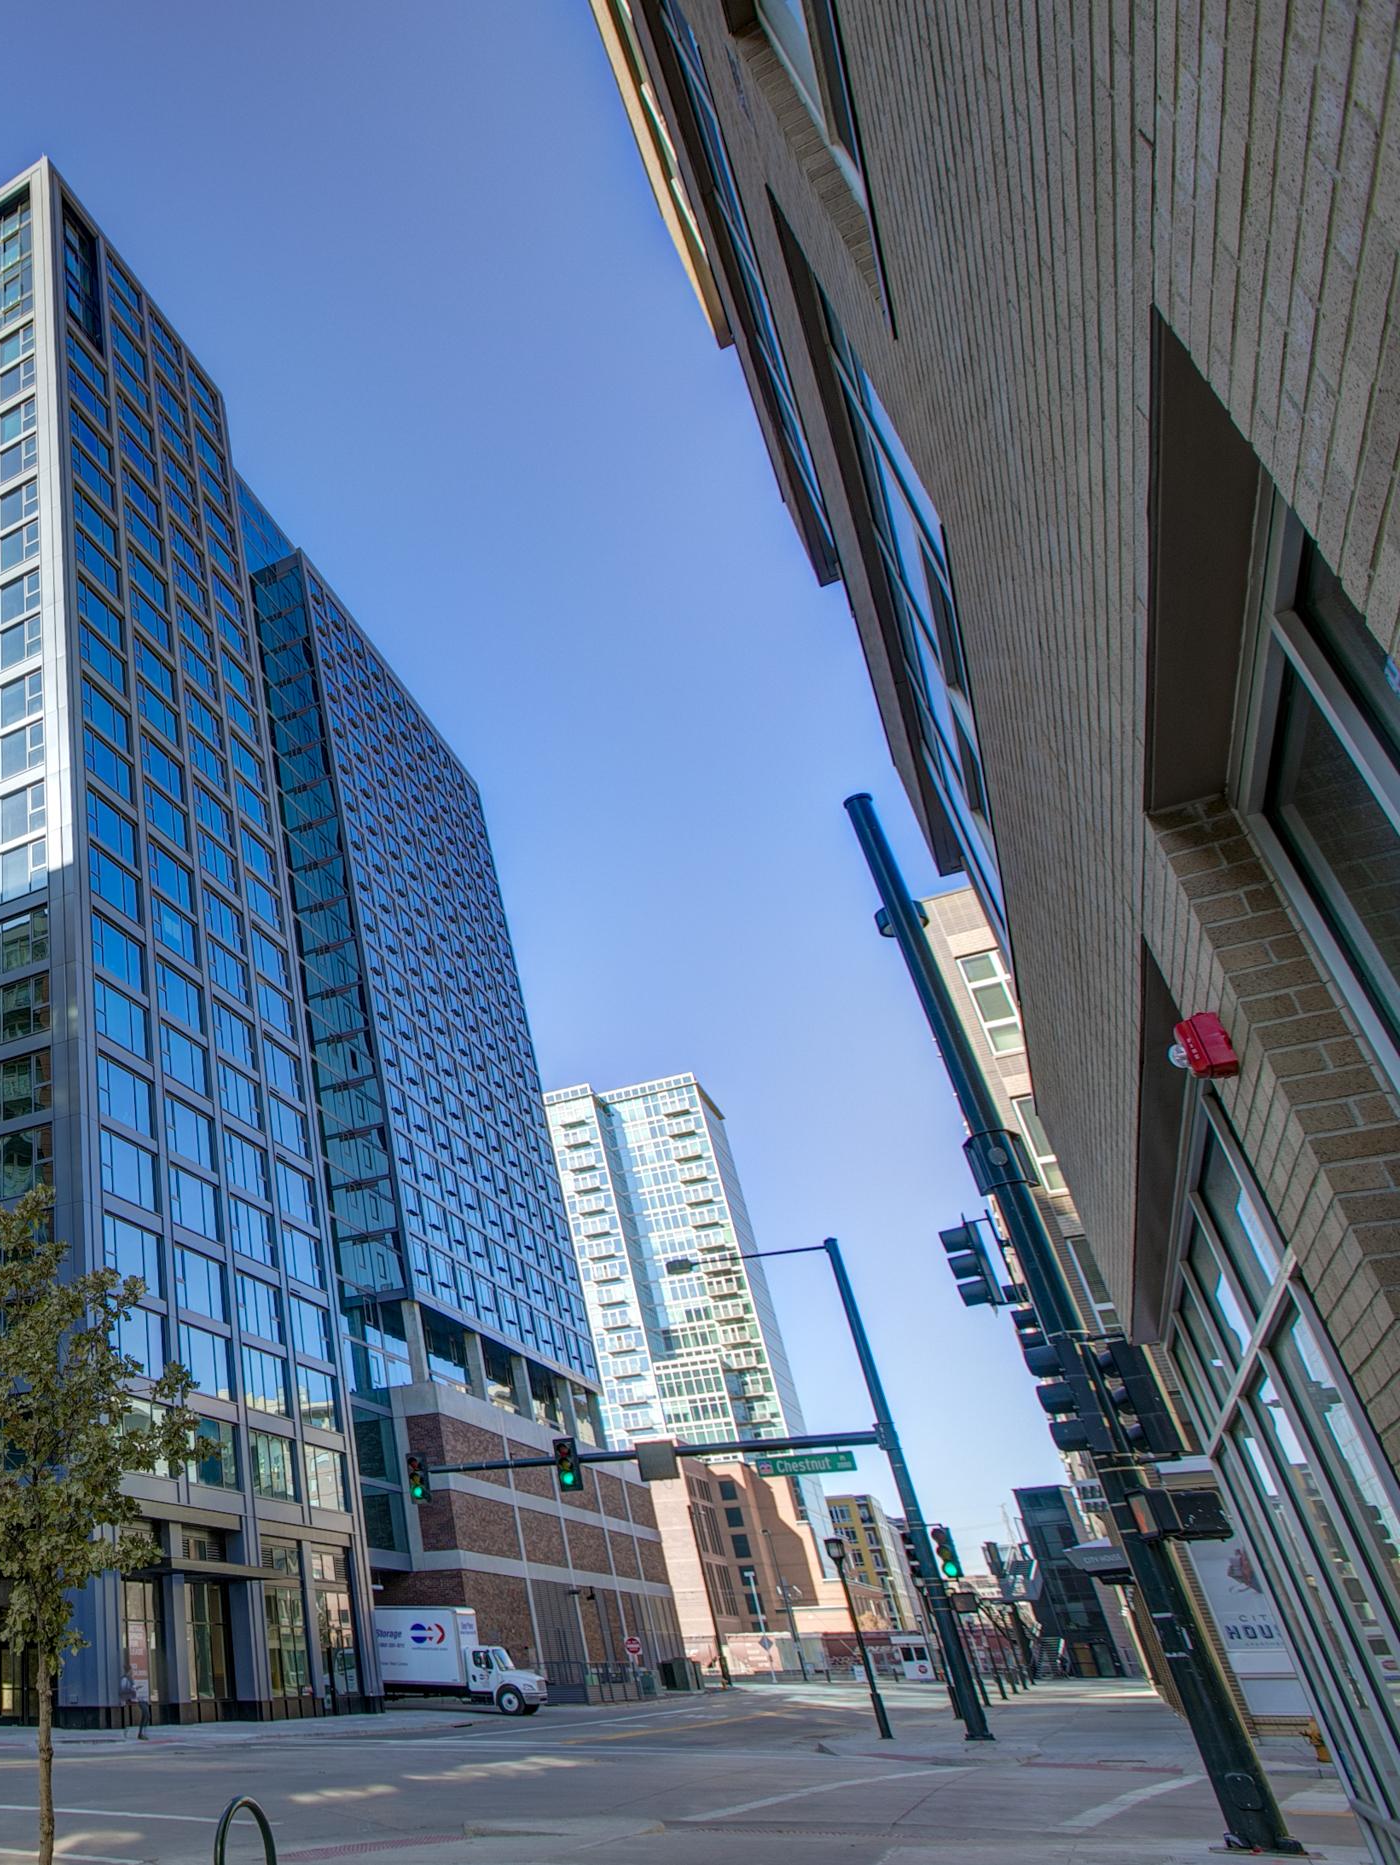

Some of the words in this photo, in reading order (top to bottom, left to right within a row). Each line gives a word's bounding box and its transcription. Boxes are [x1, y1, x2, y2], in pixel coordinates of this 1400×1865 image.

[776, 1457, 831, 1472] Chestnut
[1238, 1614, 1268, 1623] CIT
[376, 1629, 401, 1640] Storage
